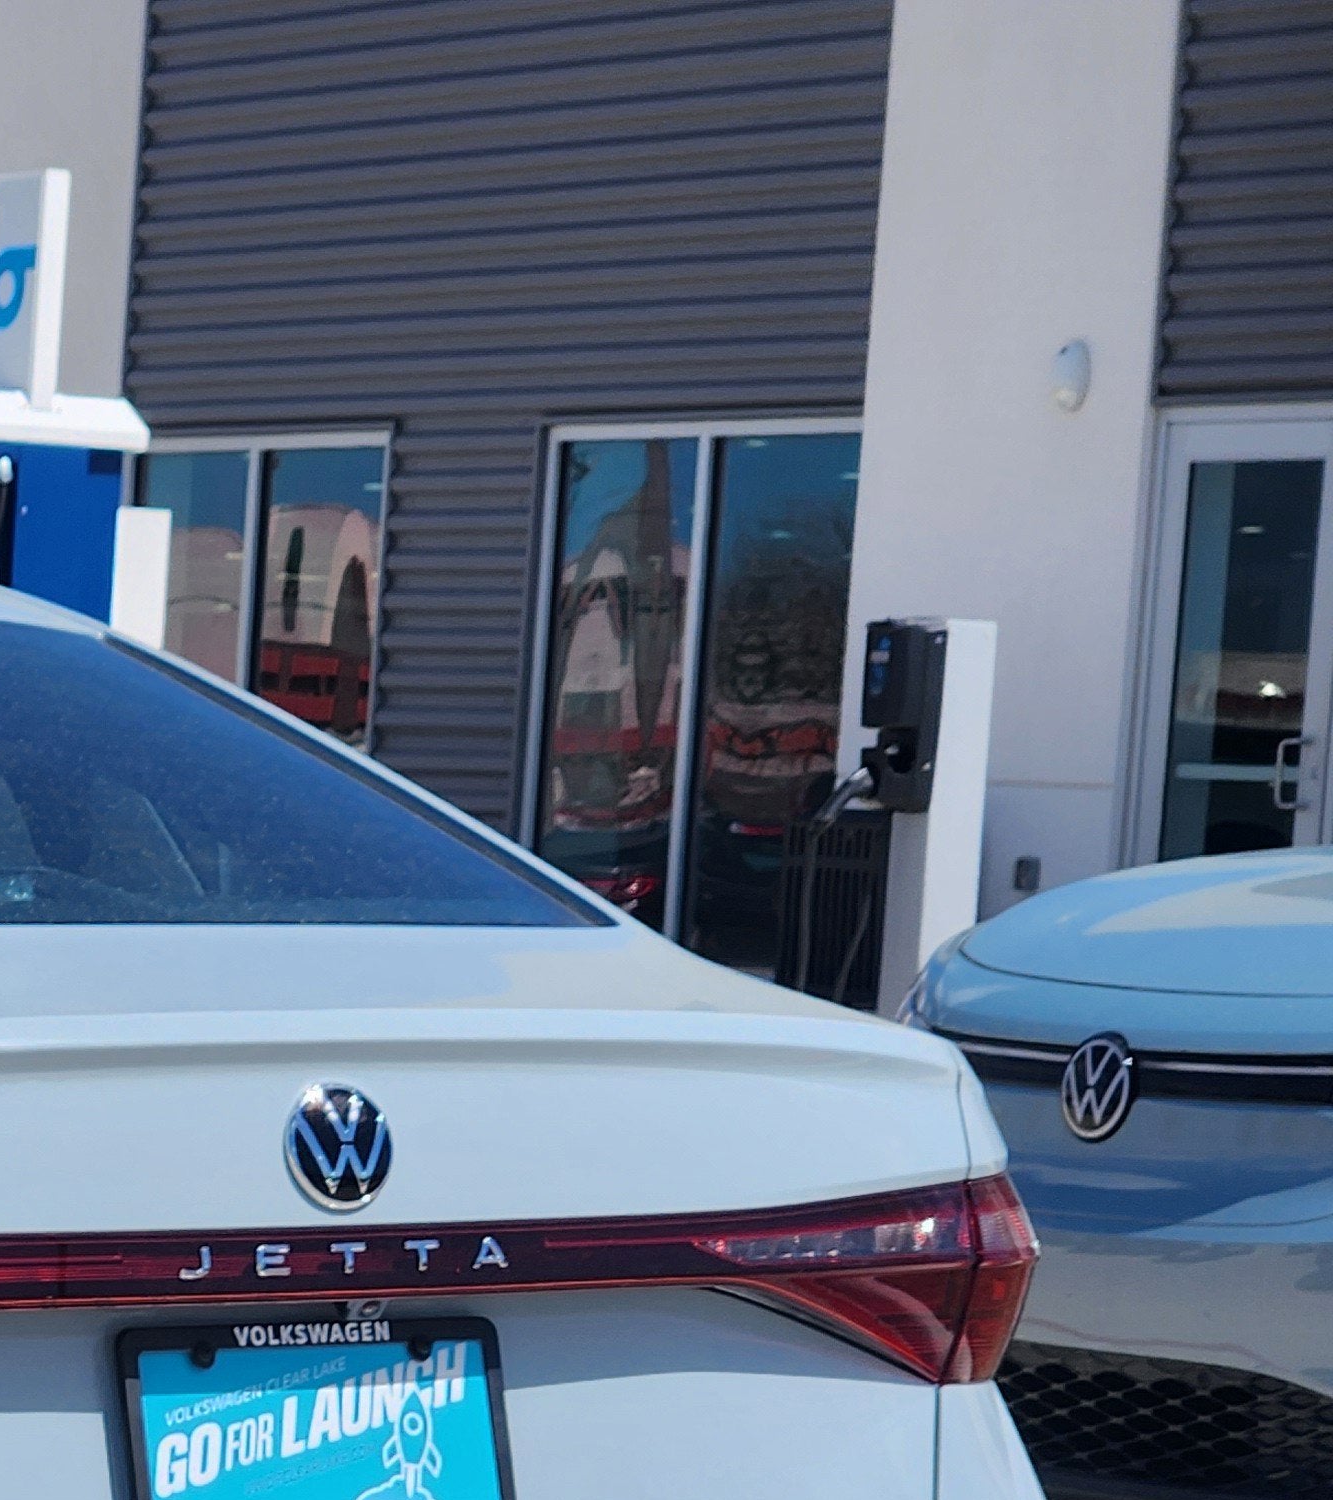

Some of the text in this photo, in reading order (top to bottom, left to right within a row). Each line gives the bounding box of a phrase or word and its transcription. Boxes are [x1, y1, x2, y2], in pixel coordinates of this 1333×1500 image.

[178, 1235, 510, 1281] JETTA
[232, 1320, 391, 1348] VOLKSWAGEN
[154, 1420, 222, 1500] GO
[224, 1411, 275, 1473] FOR
[279, 1341, 467, 1460] LAUNCH
[164, 1355, 347, 1427] VOLKSWAGEN CLEAR LAKE
